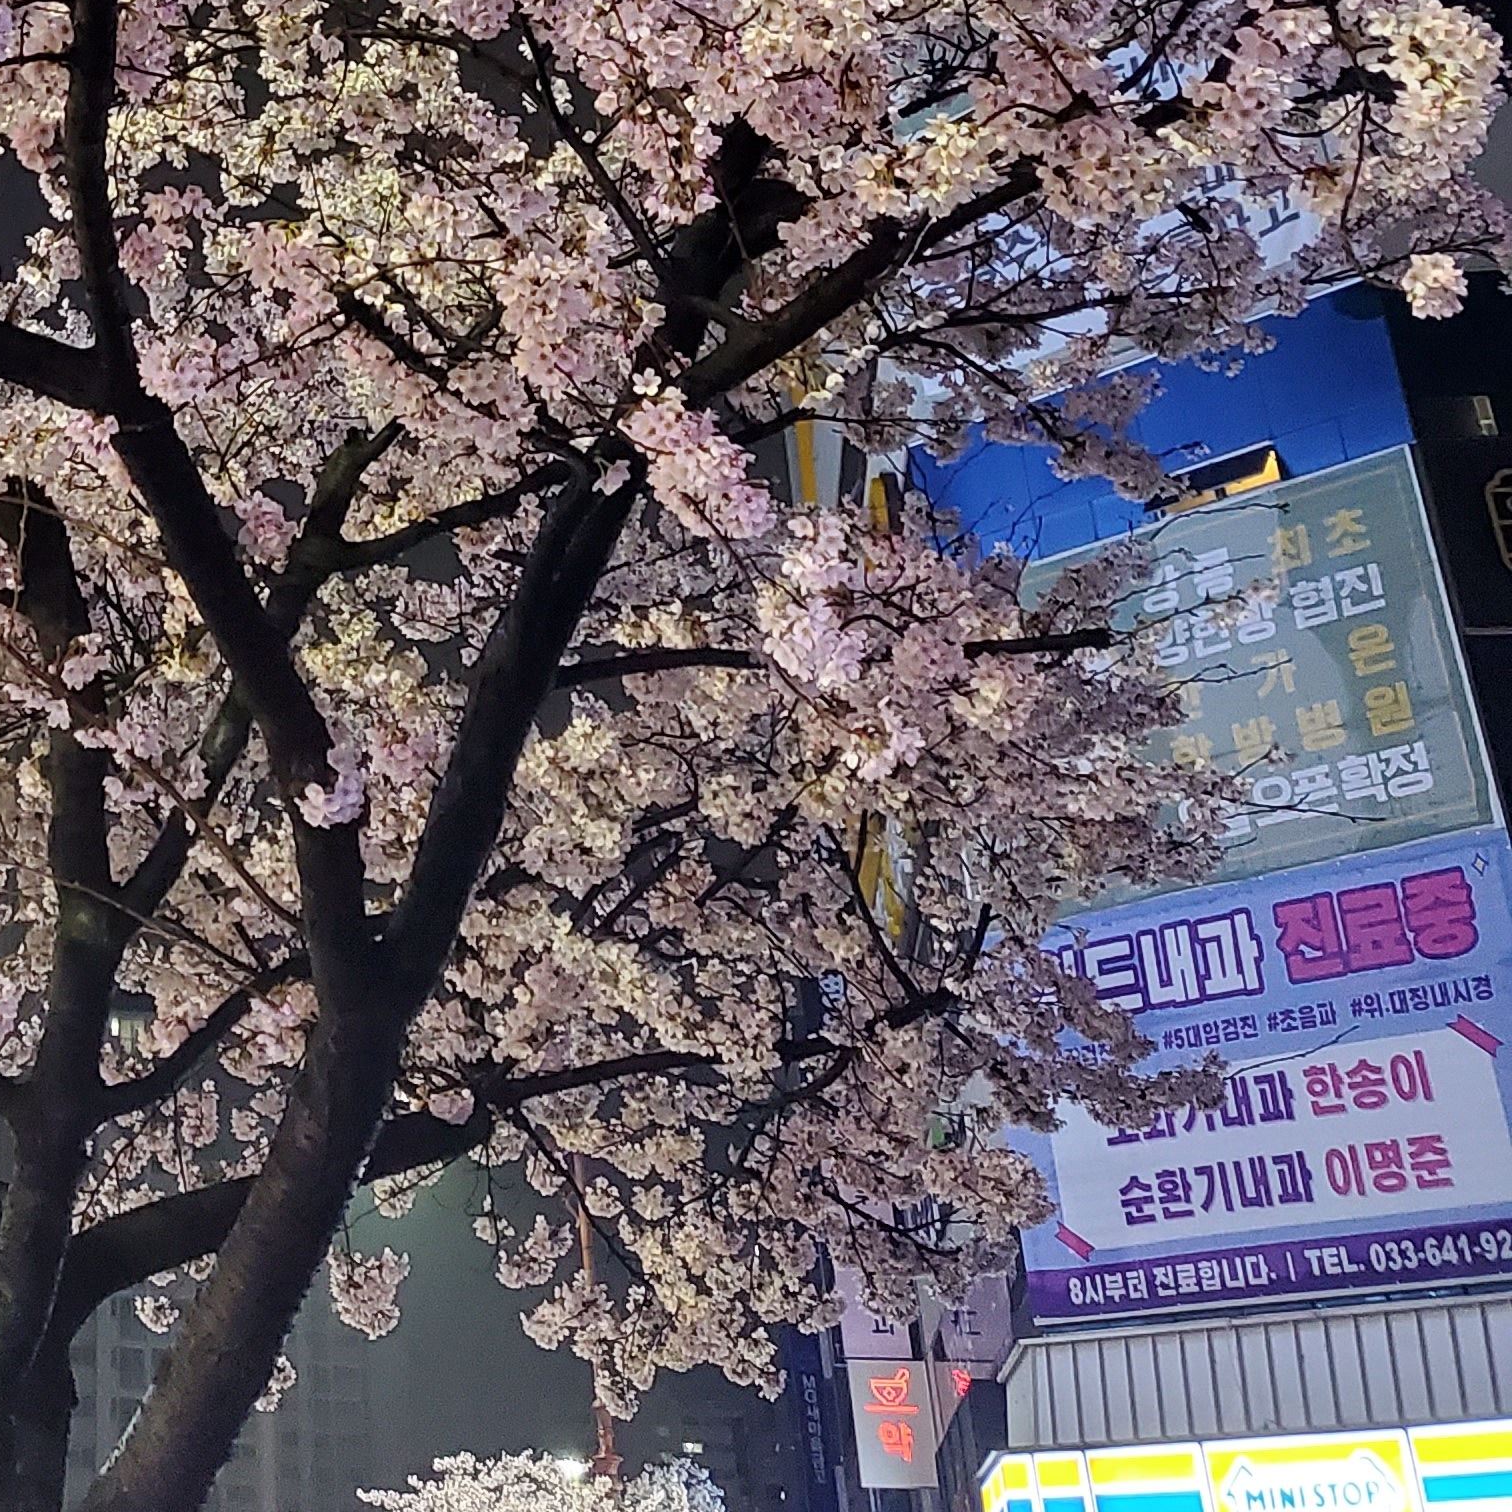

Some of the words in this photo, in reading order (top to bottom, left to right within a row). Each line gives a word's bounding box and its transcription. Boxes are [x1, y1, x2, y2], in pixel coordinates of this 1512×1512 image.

[1289, 563, 1386, 630] 협진
[1273, 865, 1480, 985] 진료중
[1161, 1013, 1260, 1051] #5대암검진
[1267, 1002, 1338, 1034] #초음파
[1302, 1049, 1436, 1119] 한송이
[1118, 1149, 1316, 1227] 순환기내과
[1324, 1133, 1457, 1198] 이명준
[1067, 1268, 1150, 1306] 8시부터
[1303, 1246, 1366, 1277] TEL.
[877, 1421, 915, 1464] 약
[1245, 1481, 1380, 1511] MINISTOP
